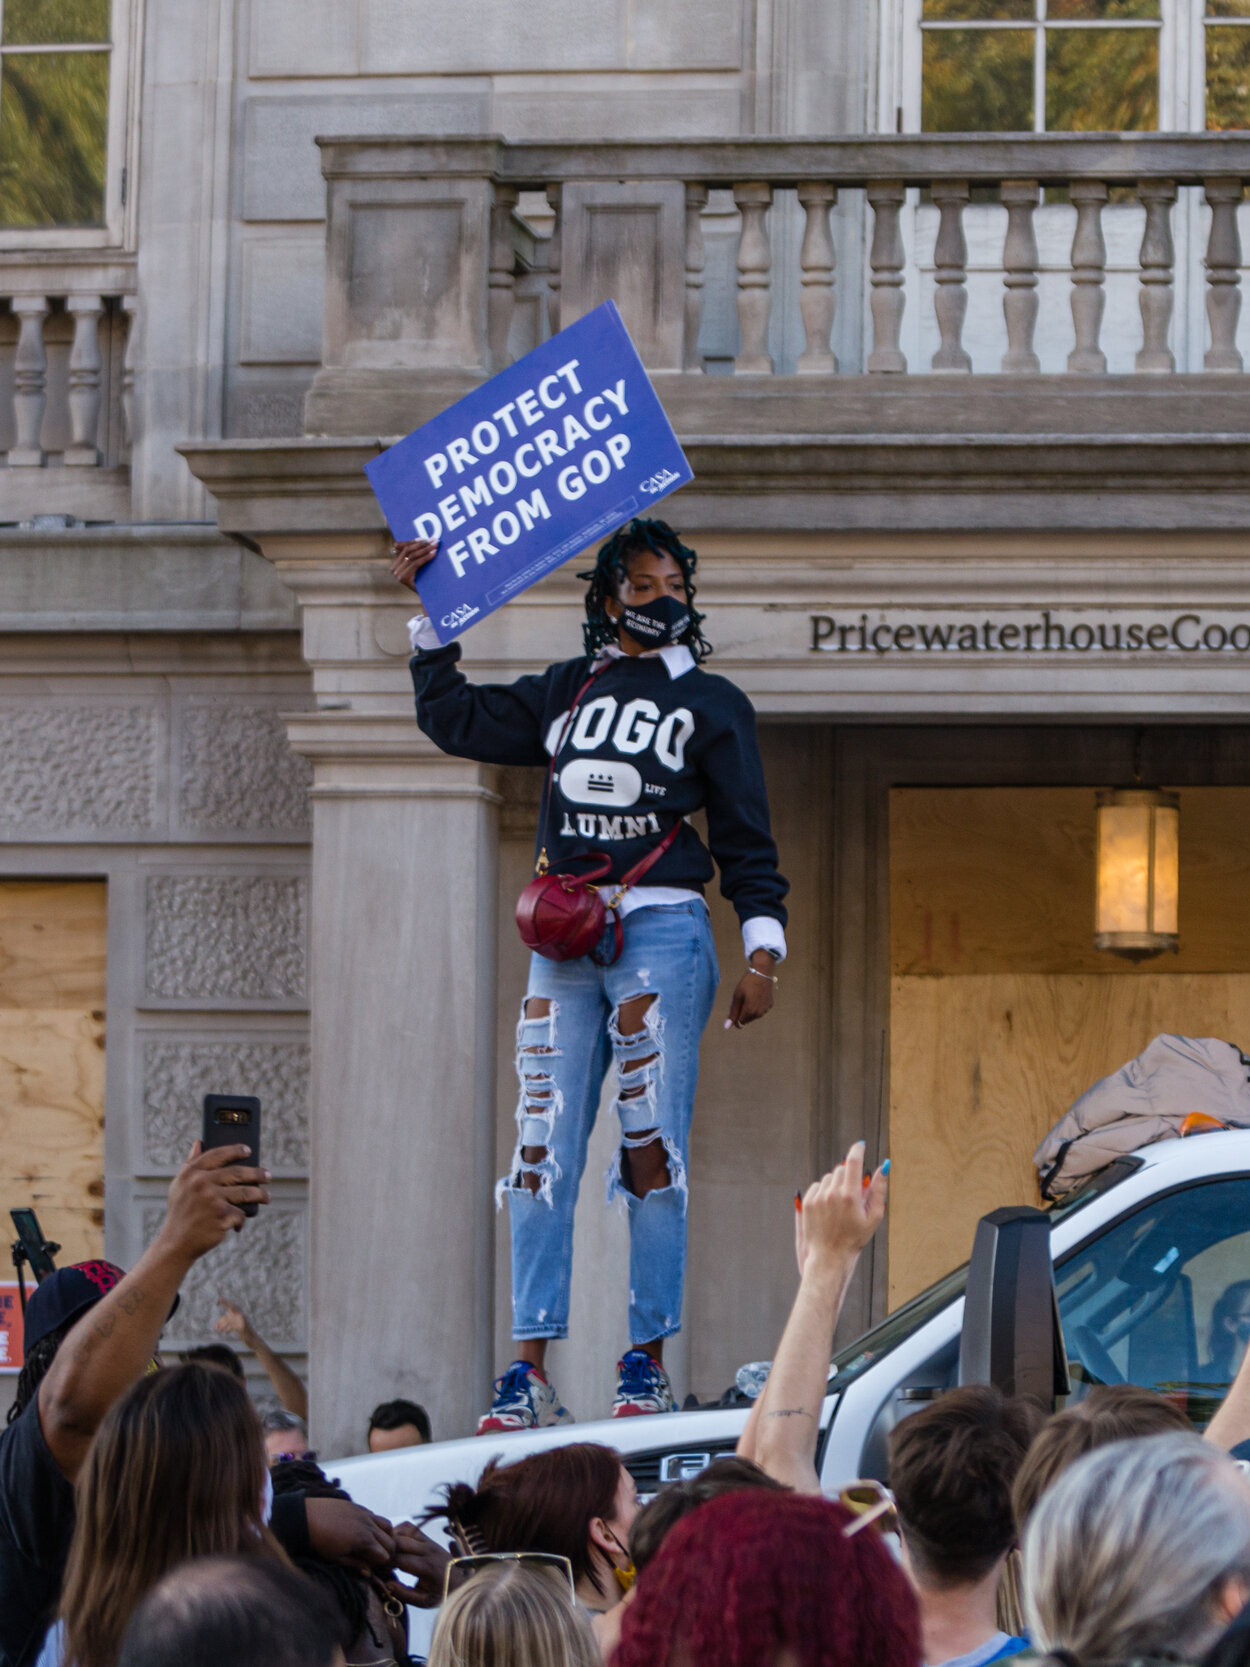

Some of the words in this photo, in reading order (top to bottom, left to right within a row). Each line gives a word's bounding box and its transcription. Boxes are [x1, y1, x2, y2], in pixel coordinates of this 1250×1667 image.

[412, 379, 630, 544] DEMOCRACY
[423, 358, 585, 490] PROTECT
[446, 488, 552, 578] FROM
[557, 433, 632, 502] GOP
[639, 468, 674, 492] CASA
[440, 603, 472, 627] CASA
[544, 695, 695, 773] GOGO
[645, 783, 667, 797] LIVE
